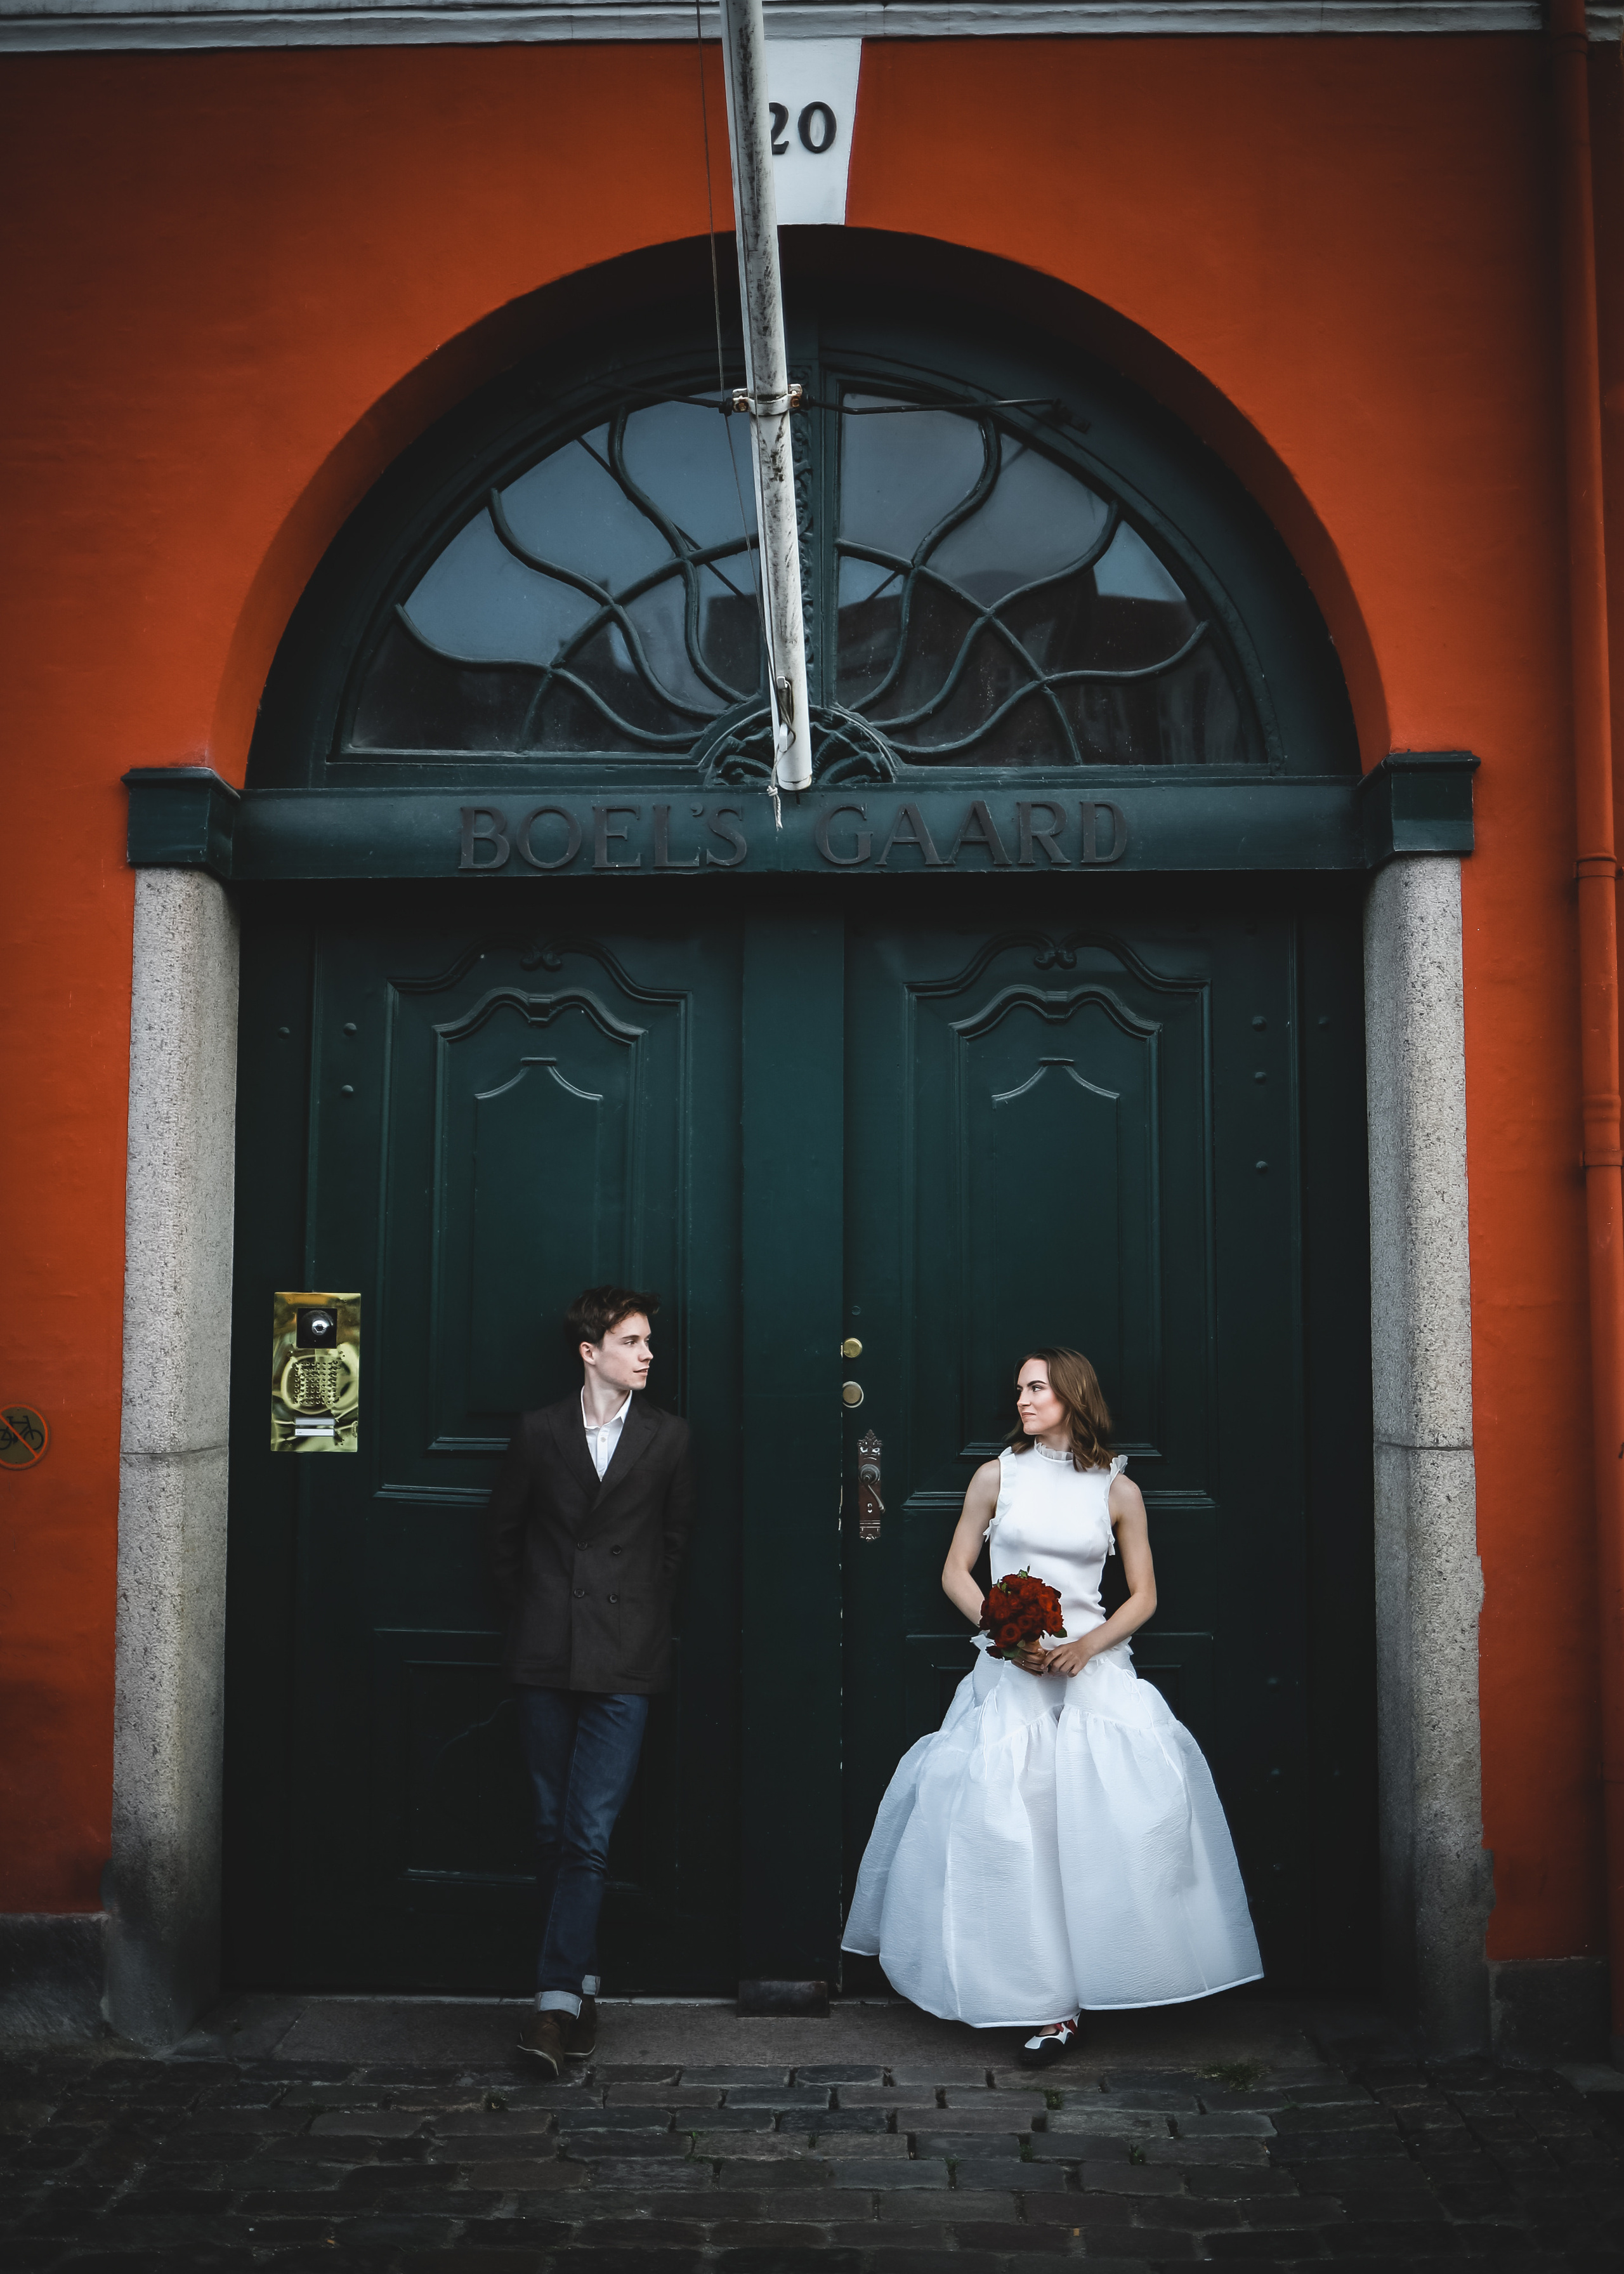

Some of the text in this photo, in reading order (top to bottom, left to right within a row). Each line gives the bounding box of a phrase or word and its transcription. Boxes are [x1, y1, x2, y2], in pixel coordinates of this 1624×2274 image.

[768, 102, 837, 155] 20
[458, 800, 1128, 869] BOEL'S GAARD
